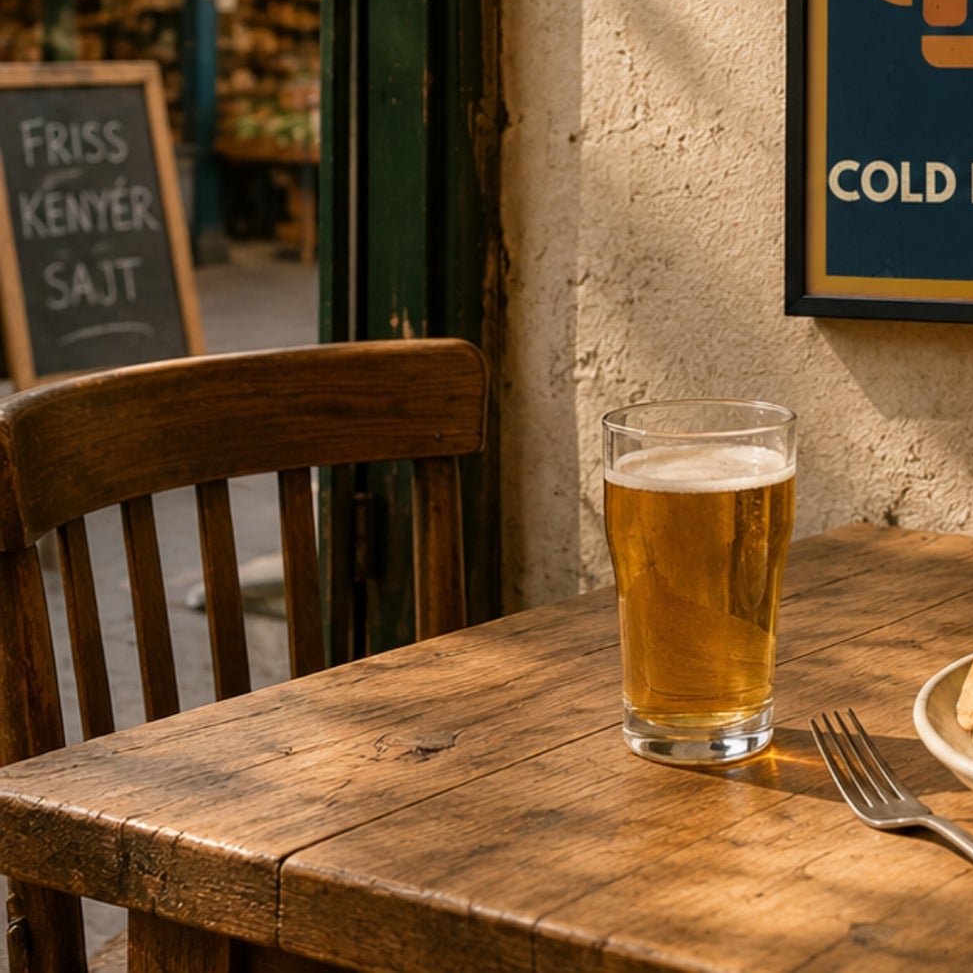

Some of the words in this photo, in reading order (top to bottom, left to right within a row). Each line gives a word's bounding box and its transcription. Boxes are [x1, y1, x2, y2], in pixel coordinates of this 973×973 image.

[19, 117, 129, 167] FRISS
[828, 160, 957, 203] COLD
[43, 256, 144, 311] SAJT
